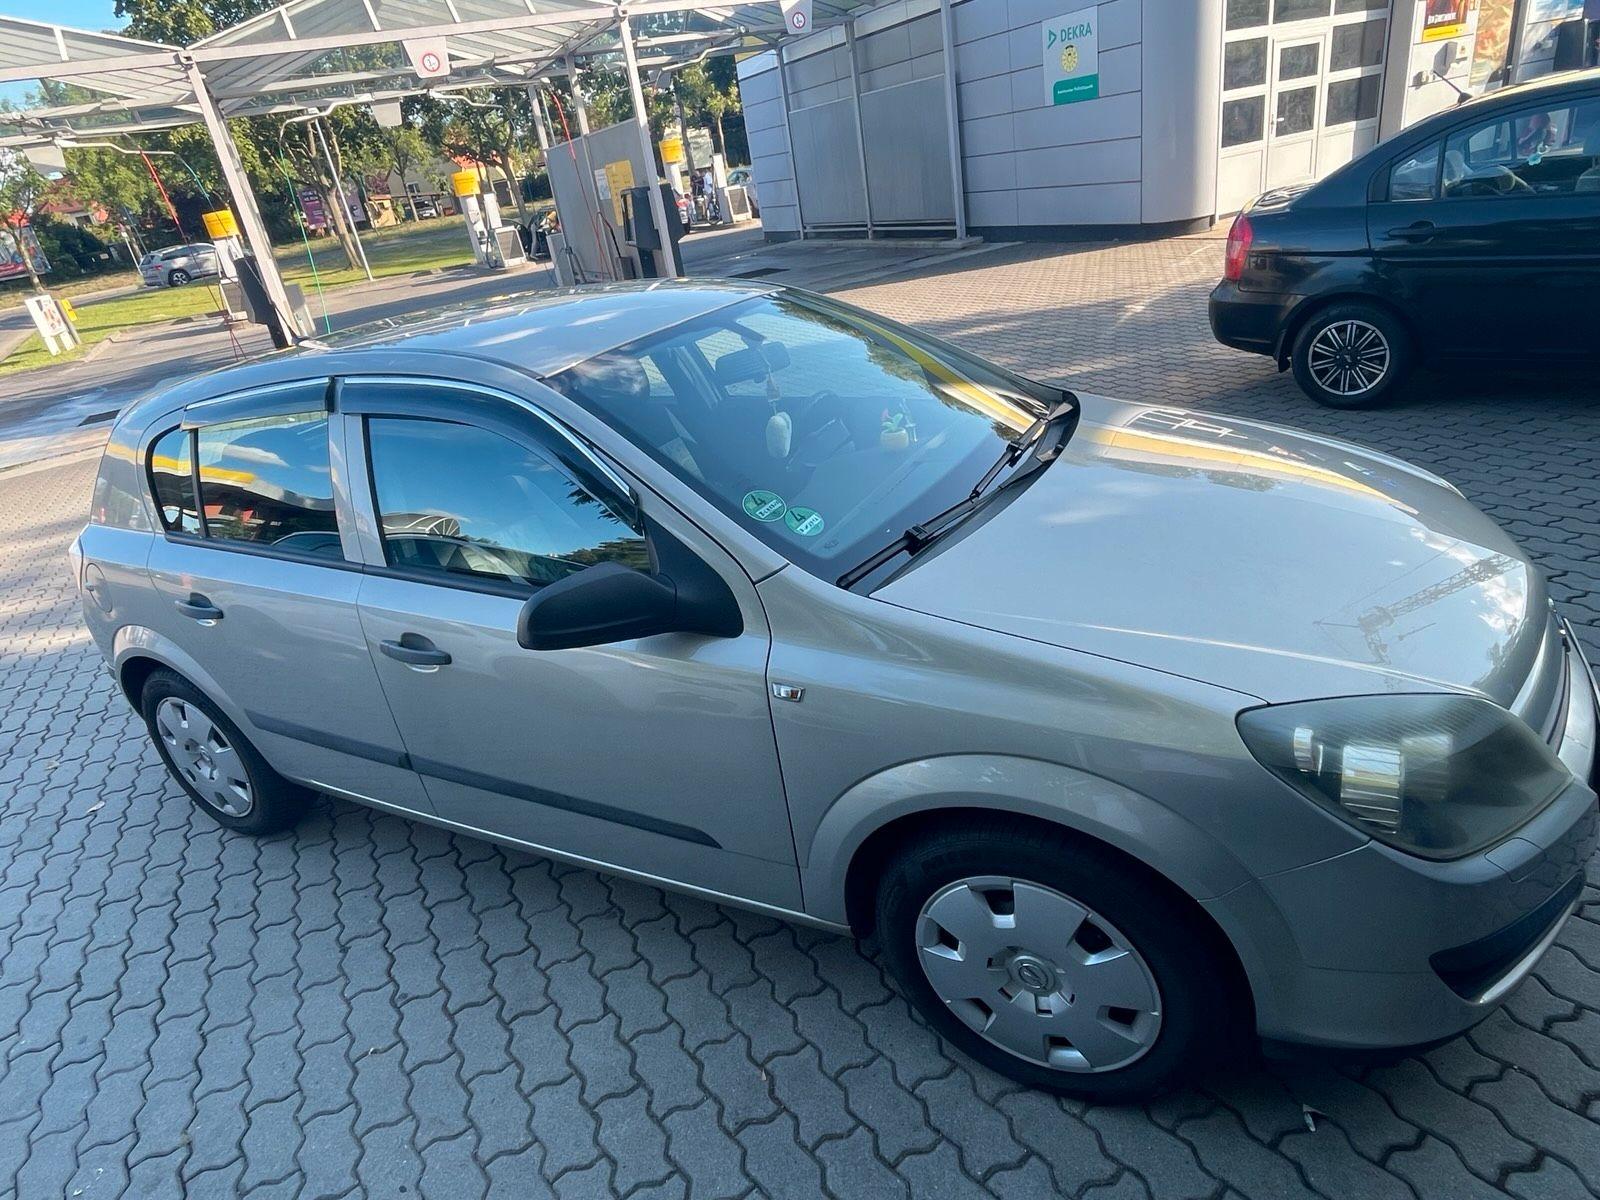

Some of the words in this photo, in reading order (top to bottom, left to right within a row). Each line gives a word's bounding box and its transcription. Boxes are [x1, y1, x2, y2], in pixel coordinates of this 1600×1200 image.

[1060, 22, 1092, 42] DEKRA
[750, 494, 767, 506] 4
[790, 510, 806, 522] 4
